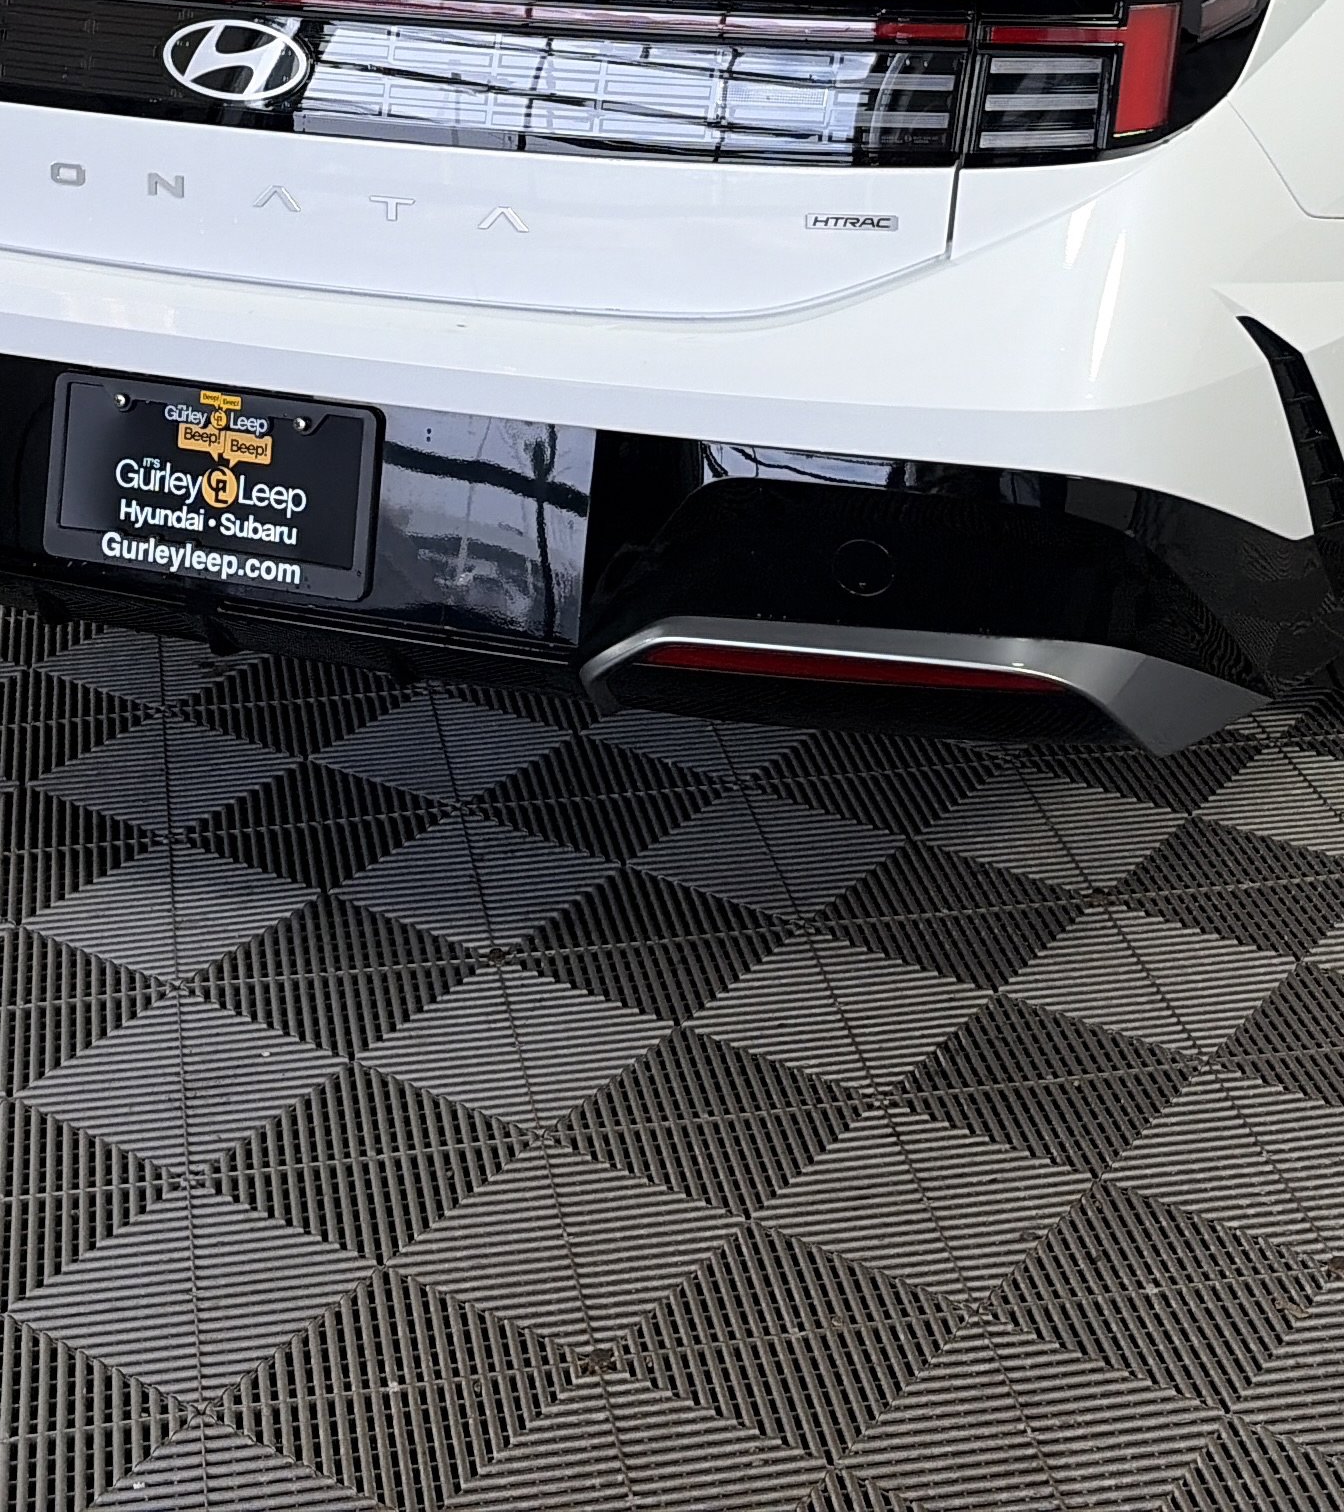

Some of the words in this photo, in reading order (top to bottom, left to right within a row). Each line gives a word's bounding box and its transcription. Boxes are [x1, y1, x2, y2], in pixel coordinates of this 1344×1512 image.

[812, 216, 891, 229] HTRAC
[164, 405, 208, 428] Gurley
[229, 412, 268, 436] Leep
[183, 426, 221, 447] Beep!
[230, 438, 268, 459] Beep!
[115, 458, 203, 505] Gurley
[237, 474, 307, 519] Leep
[119, 498, 205, 532] Hyundai
[219, 513, 298, 545] Subaru
[101, 531, 302, 584] Gurleyleep.com
